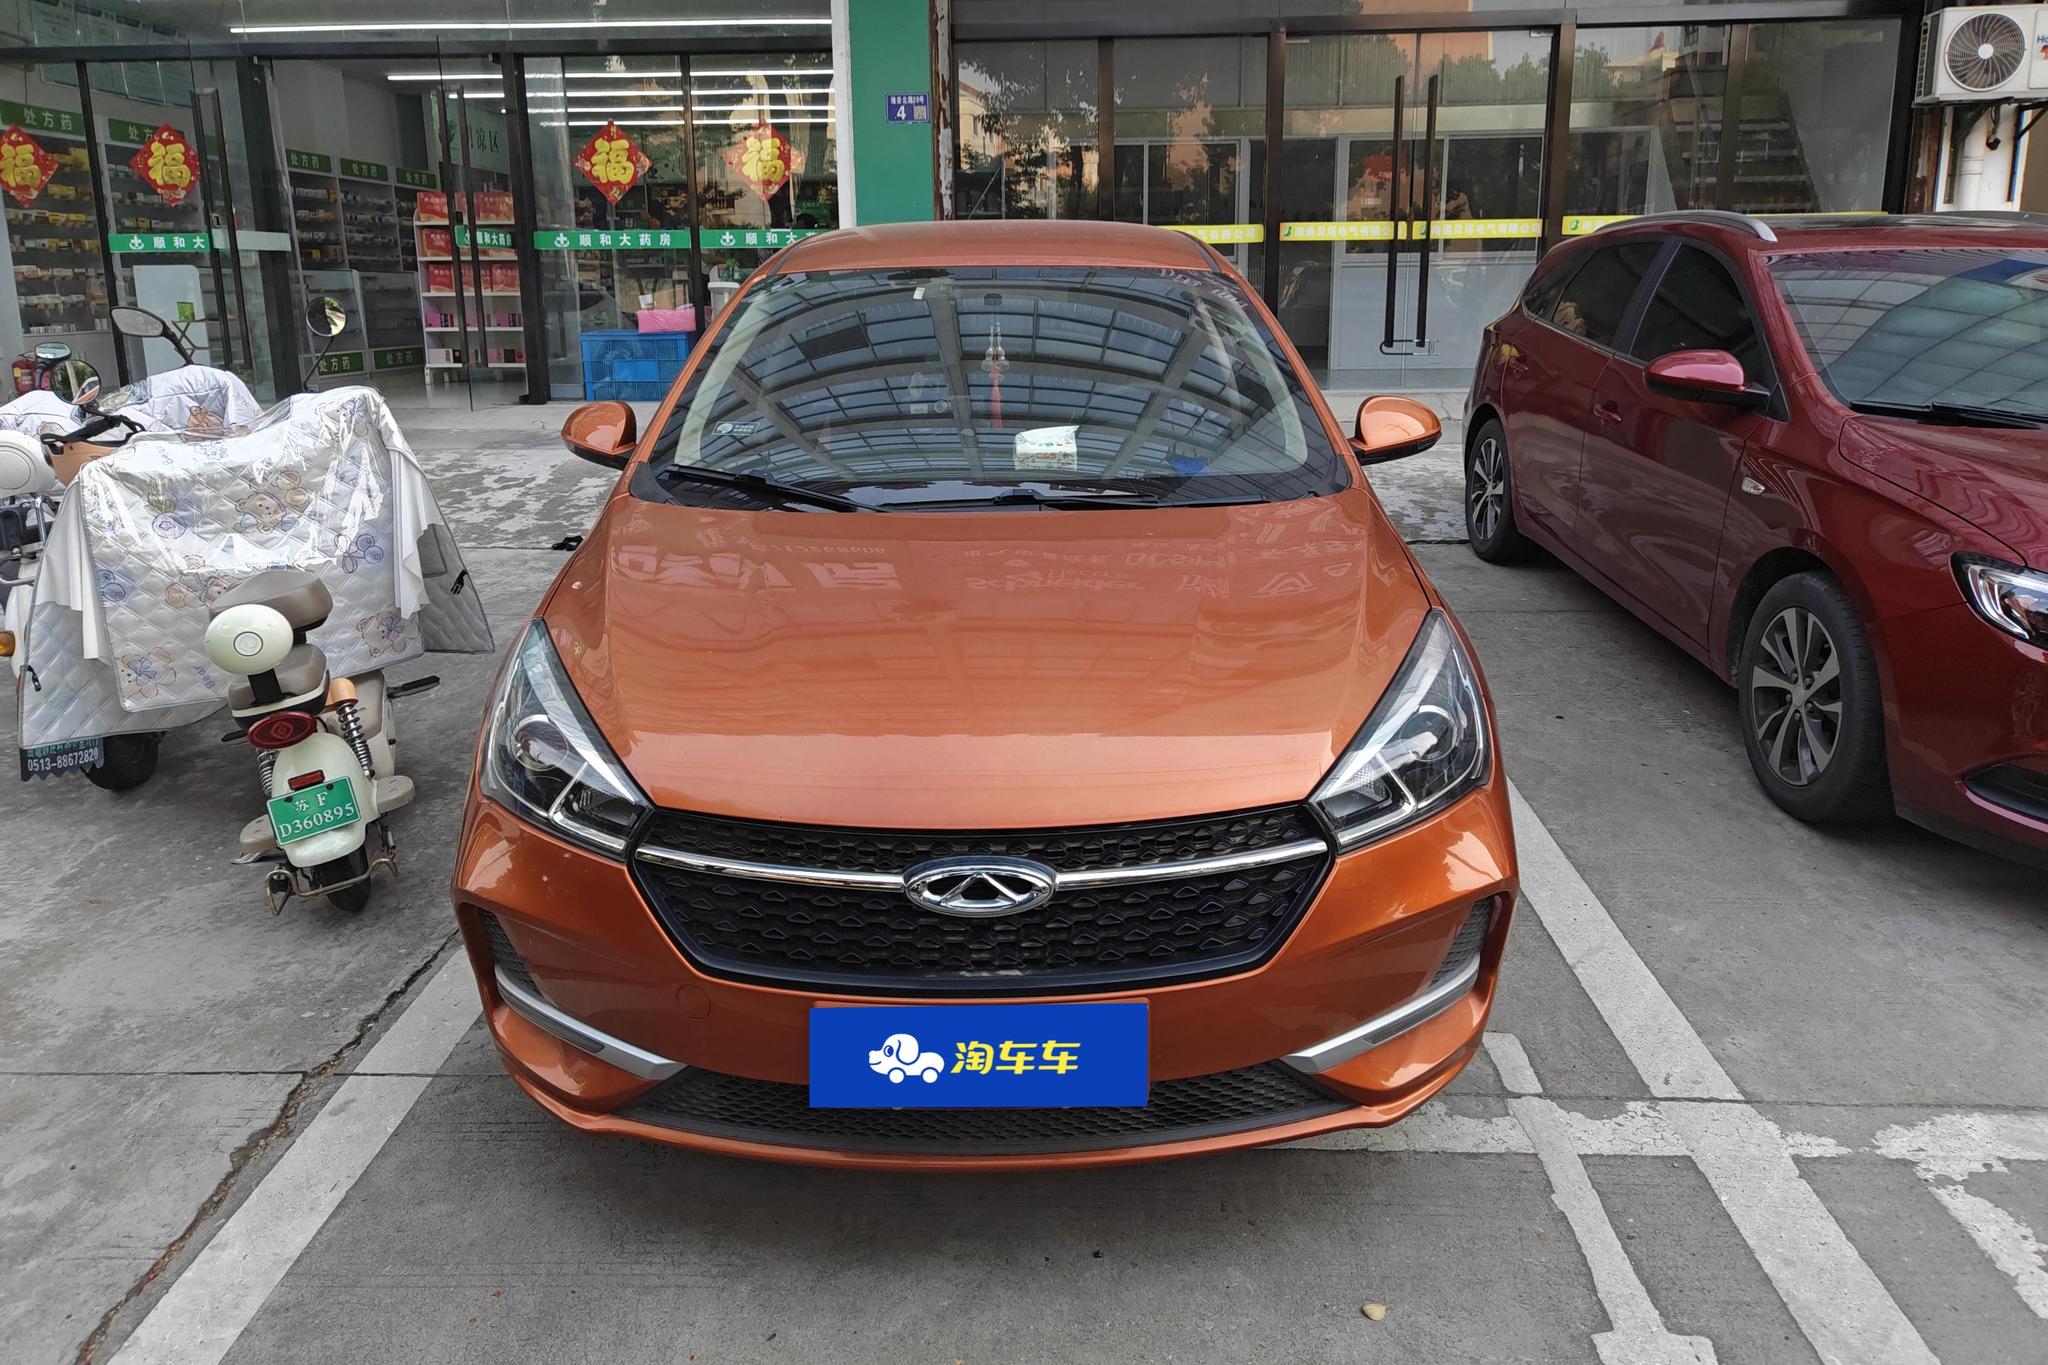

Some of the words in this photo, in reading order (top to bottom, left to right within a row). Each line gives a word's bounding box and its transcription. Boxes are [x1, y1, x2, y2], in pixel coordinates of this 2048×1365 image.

[24, 108, 72, 131] 处方药
[896, 105, 906, 120] 4
[0, 142, 42, 188] 福
[148, 141, 191, 187] 福
[290, 151, 319, 169] 处方药
[352, 161, 377, 177] 处方药
[591, 137, 635, 184] 福
[741, 136, 785, 182] 福
[405, 172, 428, 185] 处方药
[153, 236, 205, 249] 顺和大
[579, 233, 671, 247] 顺和大药房
[319, 355, 351, 372] 处方药
[386, 347, 414, 365] 处方药
[27, 747, 99, 772] 0513-88672820
[294, 799, 309, 814] 苏
[316, 791, 328, 806] F
[279, 802, 354, 838] D360895
